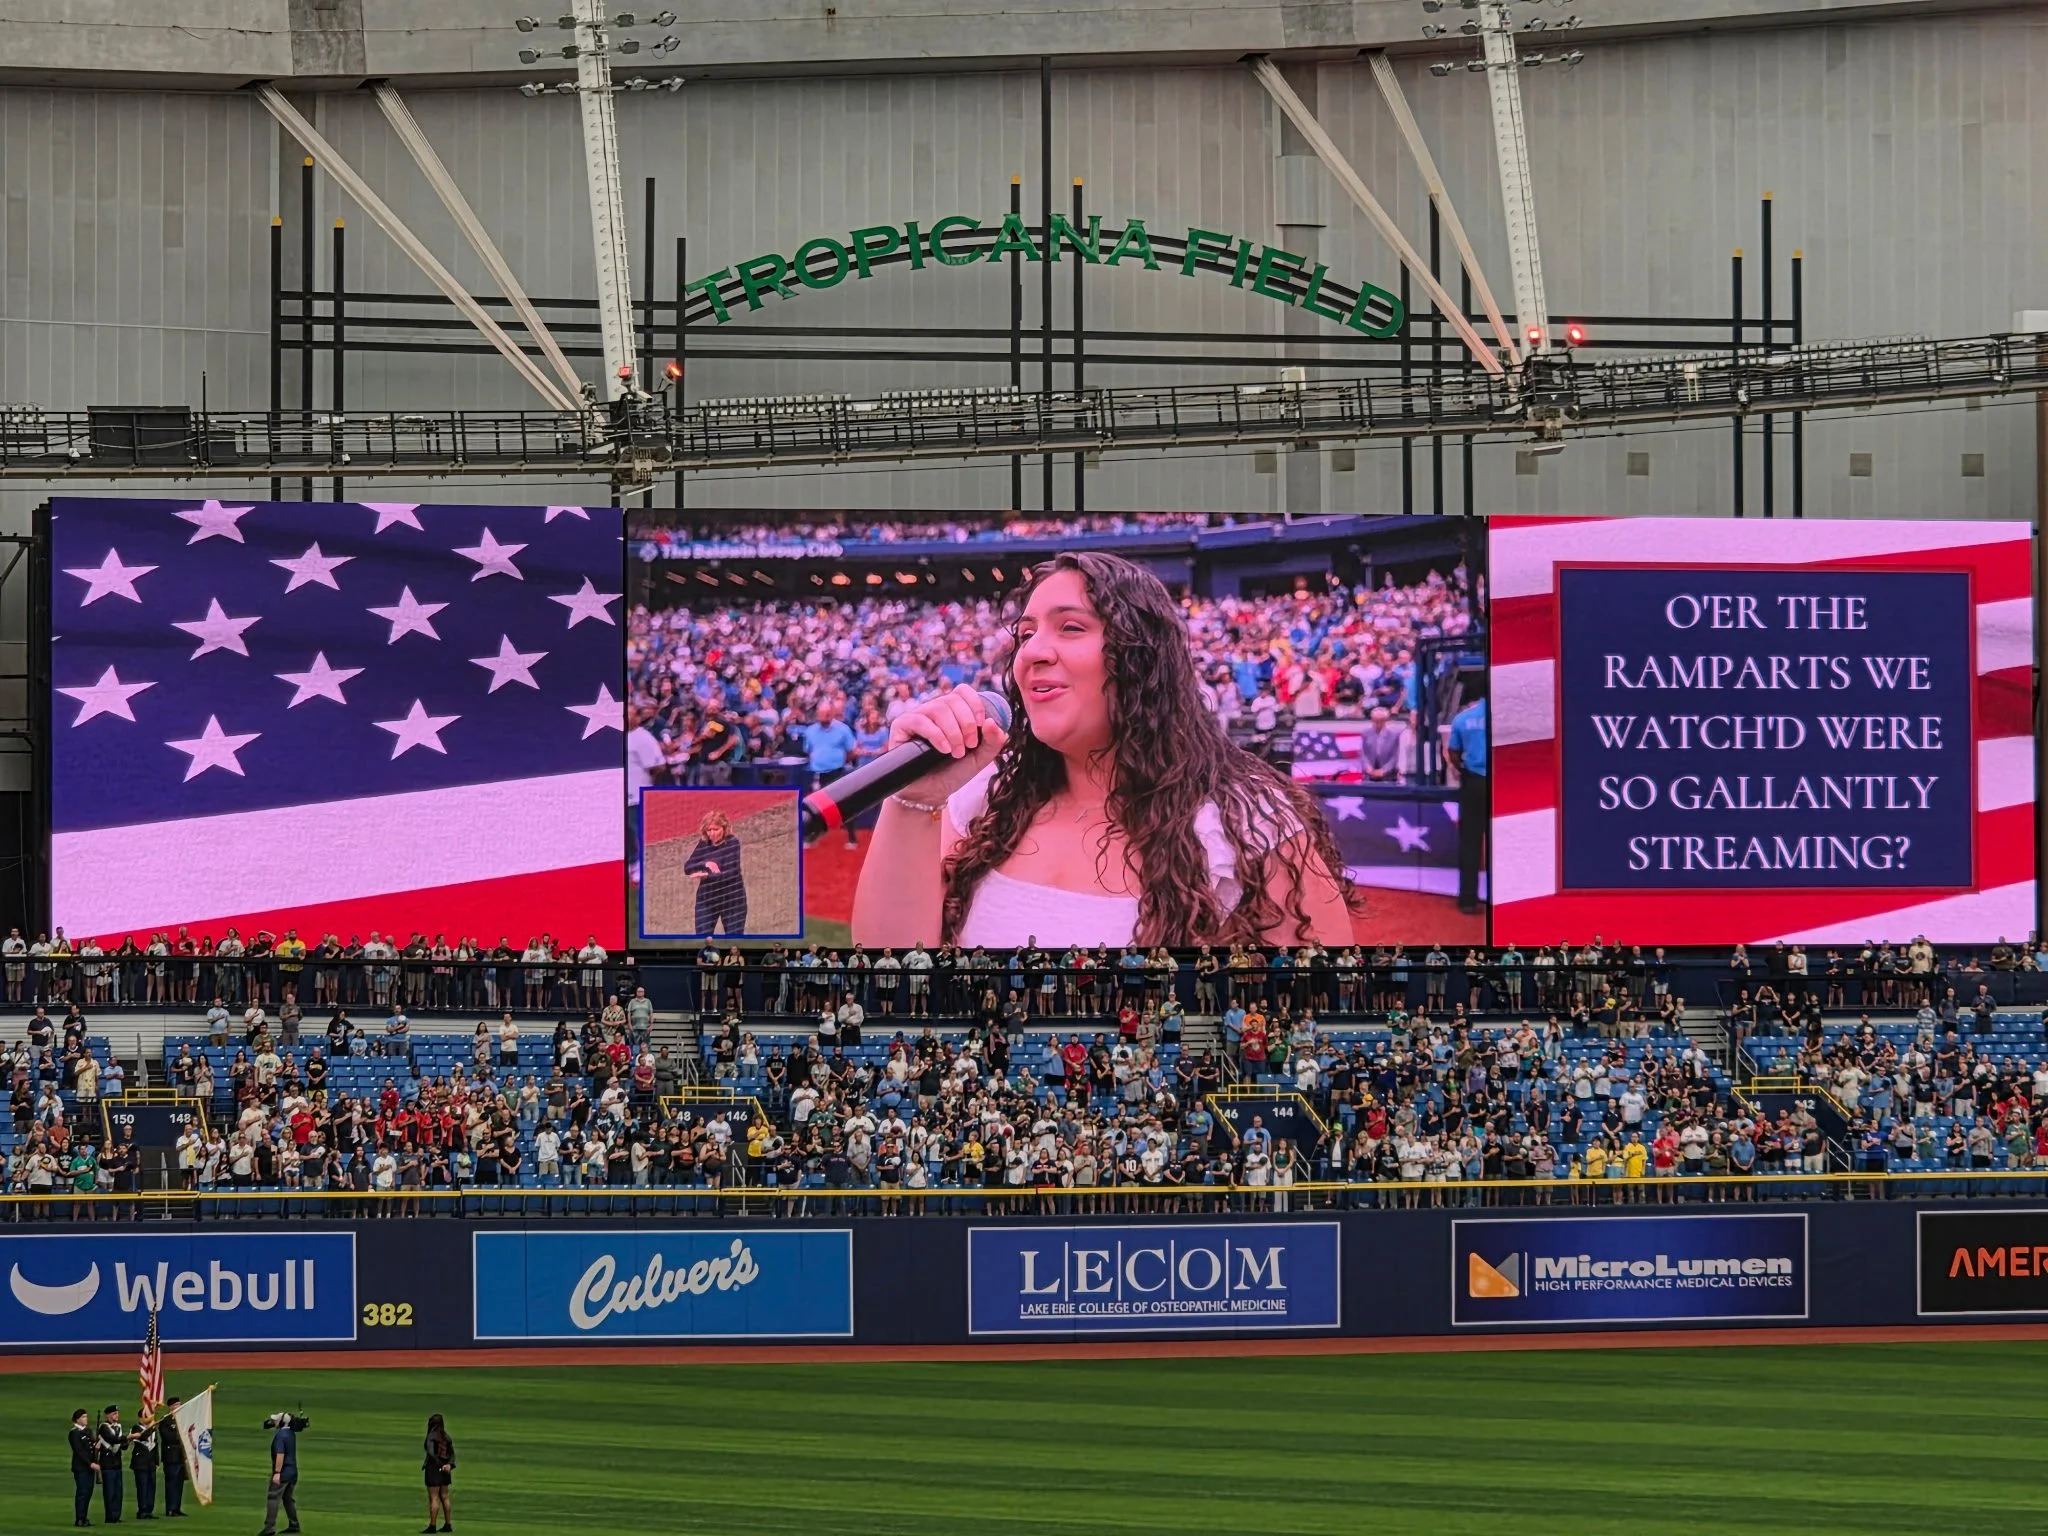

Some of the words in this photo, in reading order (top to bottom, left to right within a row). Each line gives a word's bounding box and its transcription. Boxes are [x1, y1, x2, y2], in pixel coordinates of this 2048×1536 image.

[684, 213, 1161, 324] TROPICANA
[1182, 227, 1405, 339] FIELD
[1665, 595, 1767, 629] O'ER
[1777, 596, 1869, 630] THE
[1604, 655, 1851, 689] RAMPARTS
[1862, 657, 1932, 690] WE
[1591, 714, 1806, 750] WATCH'D
[1817, 716, 1943, 750] WERE
[1600, 776, 1657, 810] SO
[1669, 776, 1939, 810] GALLANTLY
[1628, 836, 1911, 870] STREAMING?
[112, 1114, 135, 1124] 150
[169, 1113, 191, 1123] 148
[676, 1111, 691, 1121] 48
[726, 1111, 748, 1121] 146
[1272, 1107, 1294, 1117] 144
[1125, 1159, 1137, 1171] 10
[1535, 1254, 1792, 1279] MicroLumen
[115, 1259, 314, 1312] Webull
[569, 1238, 759, 1330] Culver's
[1535, 1279, 1570, 1292] HIGH
[1574, 1278, 1672, 1291] PERFORMANCE
[1676, 1277, 1735, 1289] MEDICAL
[1738, 1276, 1793, 1288] DEVICES
[363, 1303, 413, 1326] 382
[1020, 1303, 1049, 1315] LAKE
[1052, 1303, 1076, 1314] ERIE
[1078, 1302, 1129, 1314] COLLEGE
[1133, 1302, 1148, 1313] OF
[1151, 1300, 1228, 1313] OSTEOPATHIC
[1230, 1299, 1286, 1311] MEDICINE
